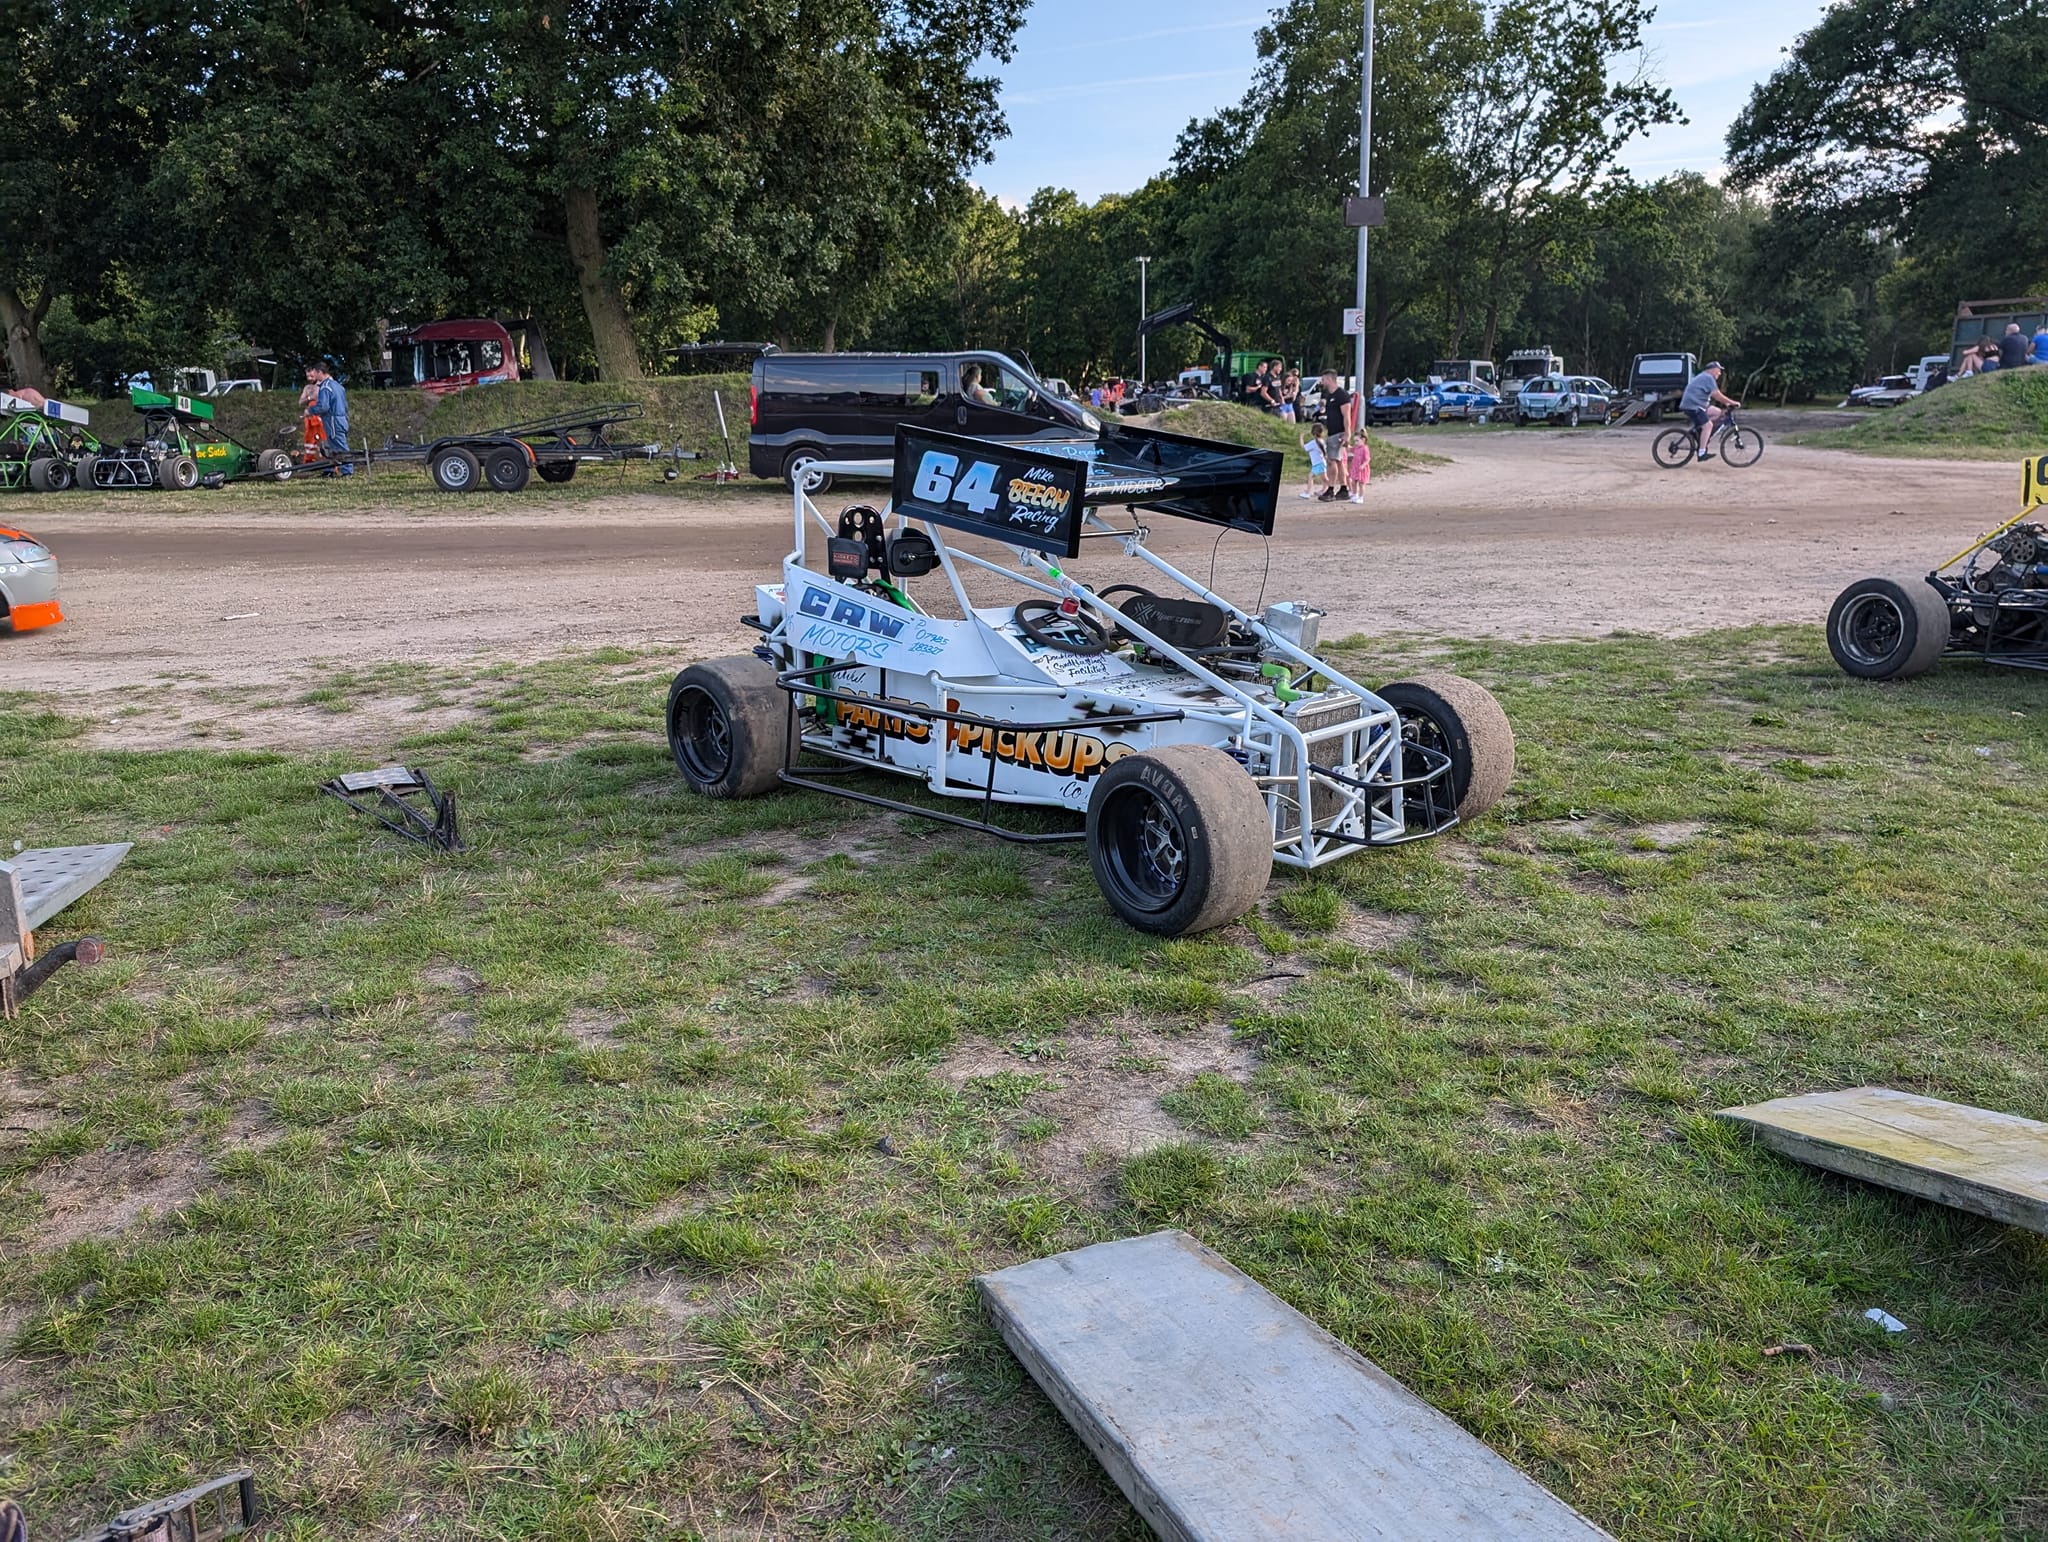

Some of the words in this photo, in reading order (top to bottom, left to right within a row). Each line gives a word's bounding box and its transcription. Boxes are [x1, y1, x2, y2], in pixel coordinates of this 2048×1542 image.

[912, 450, 1000, 514] 64
[1023, 466, 1055, 483] Mike
[1008, 478, 1071, 513] BEECH
[1008, 504, 1059, 535] Racing
[800, 586, 905, 639] CRW
[800, 623, 889, 659] MOTORS
[1140, 765, 1190, 816] AVON
